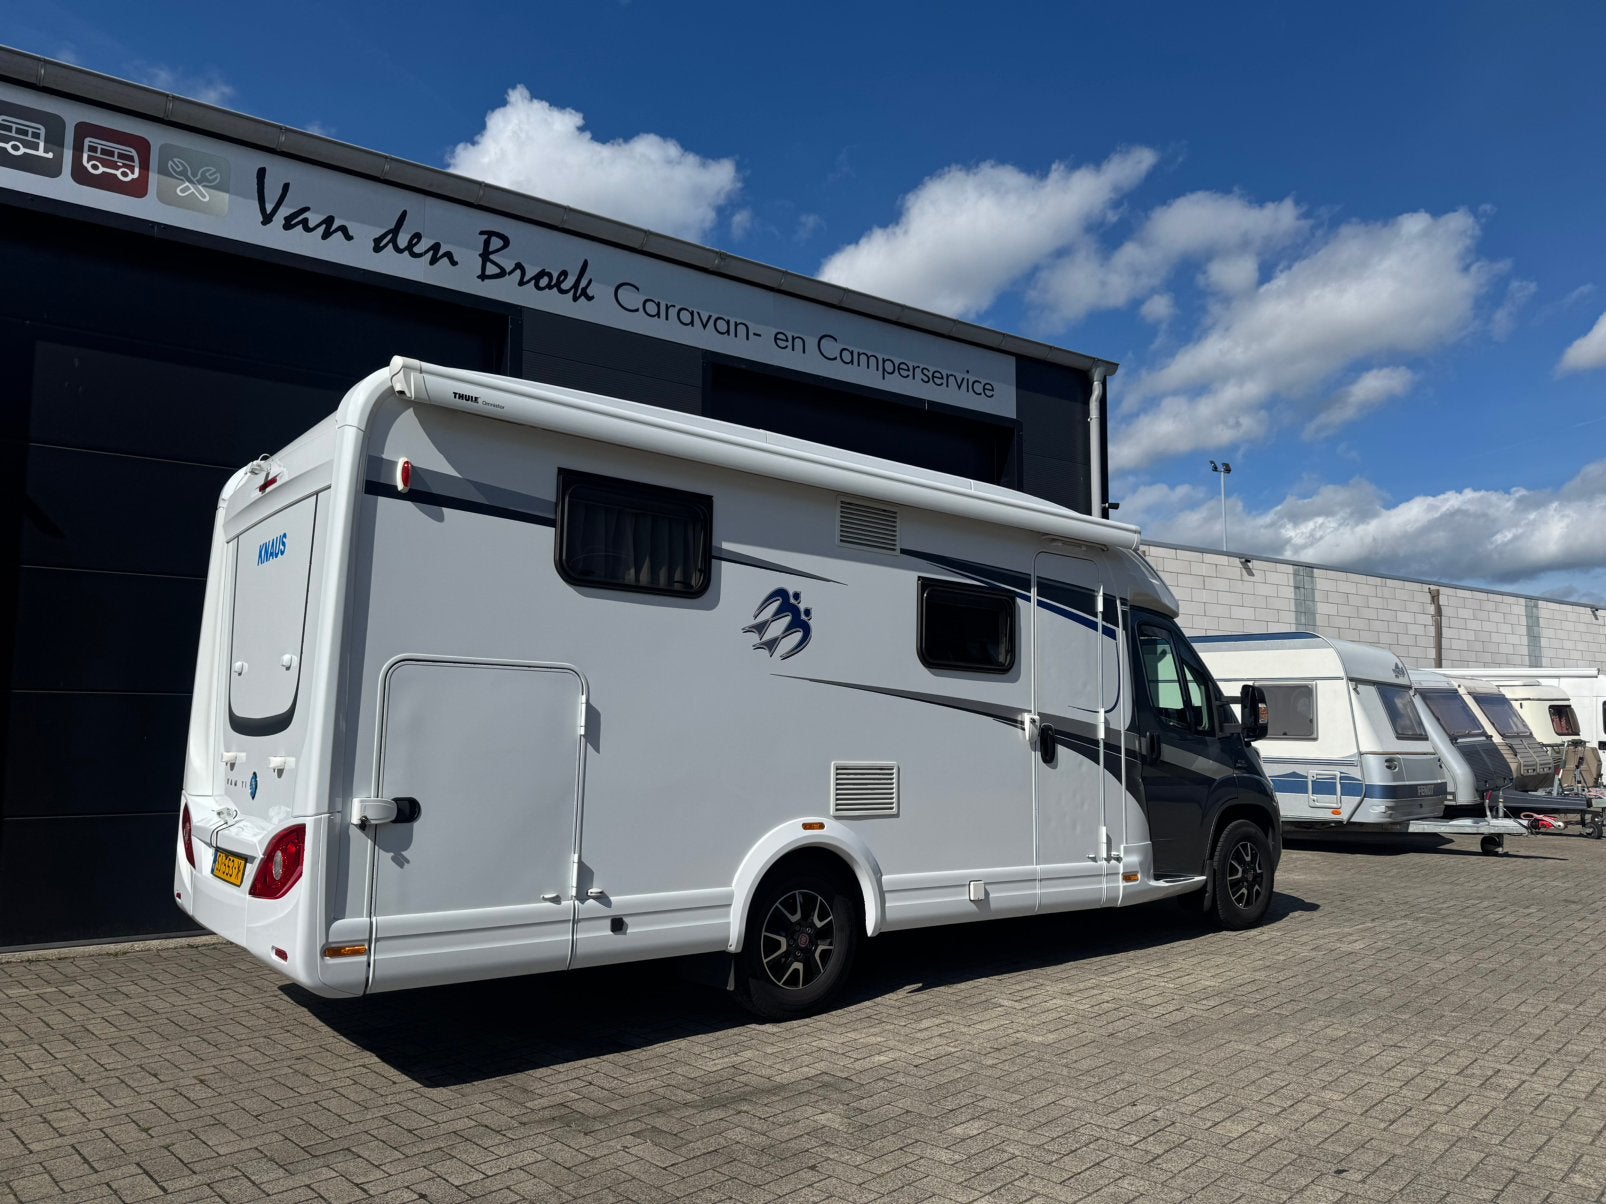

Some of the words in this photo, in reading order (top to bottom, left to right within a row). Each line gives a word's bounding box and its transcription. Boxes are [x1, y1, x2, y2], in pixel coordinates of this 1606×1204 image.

[256, 167, 354, 241] Van
[372, 209, 458, 266] den
[477, 230, 595, 302] Broek
[613, 282, 762, 341] Caravan-
[773, 330, 806, 354] en
[817, 334, 995, 398] Camperservice
[453, 391, 479, 404] THULE
[257, 532, 287, 566] KNAUS
